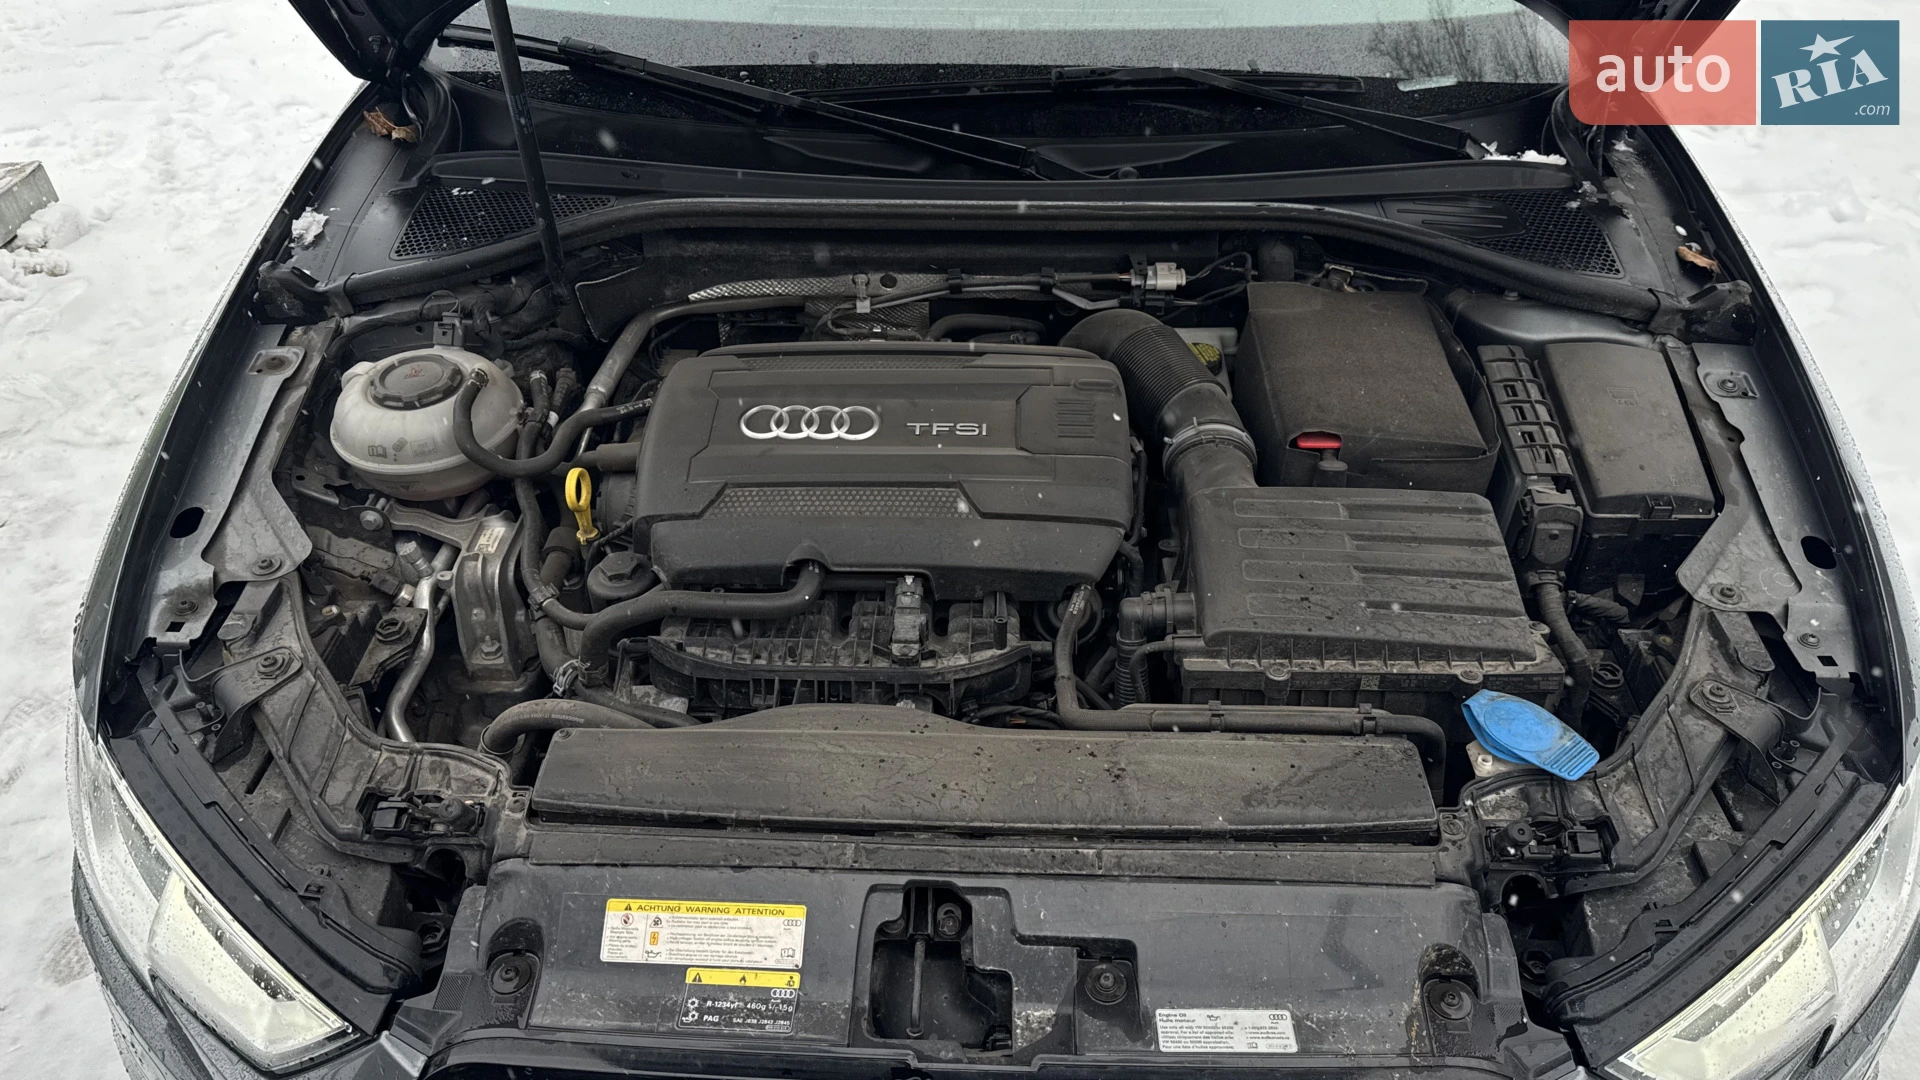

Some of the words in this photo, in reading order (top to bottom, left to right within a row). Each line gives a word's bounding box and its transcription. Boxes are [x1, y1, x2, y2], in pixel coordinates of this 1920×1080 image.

[906, 422, 987, 436] TFSI
[636, 904, 681, 913] ACHTUNG
[685, 905, 730, 914] WARNING
[735, 907, 785, 916] ATTENTION
[703, 1014, 719, 1022] PAG
